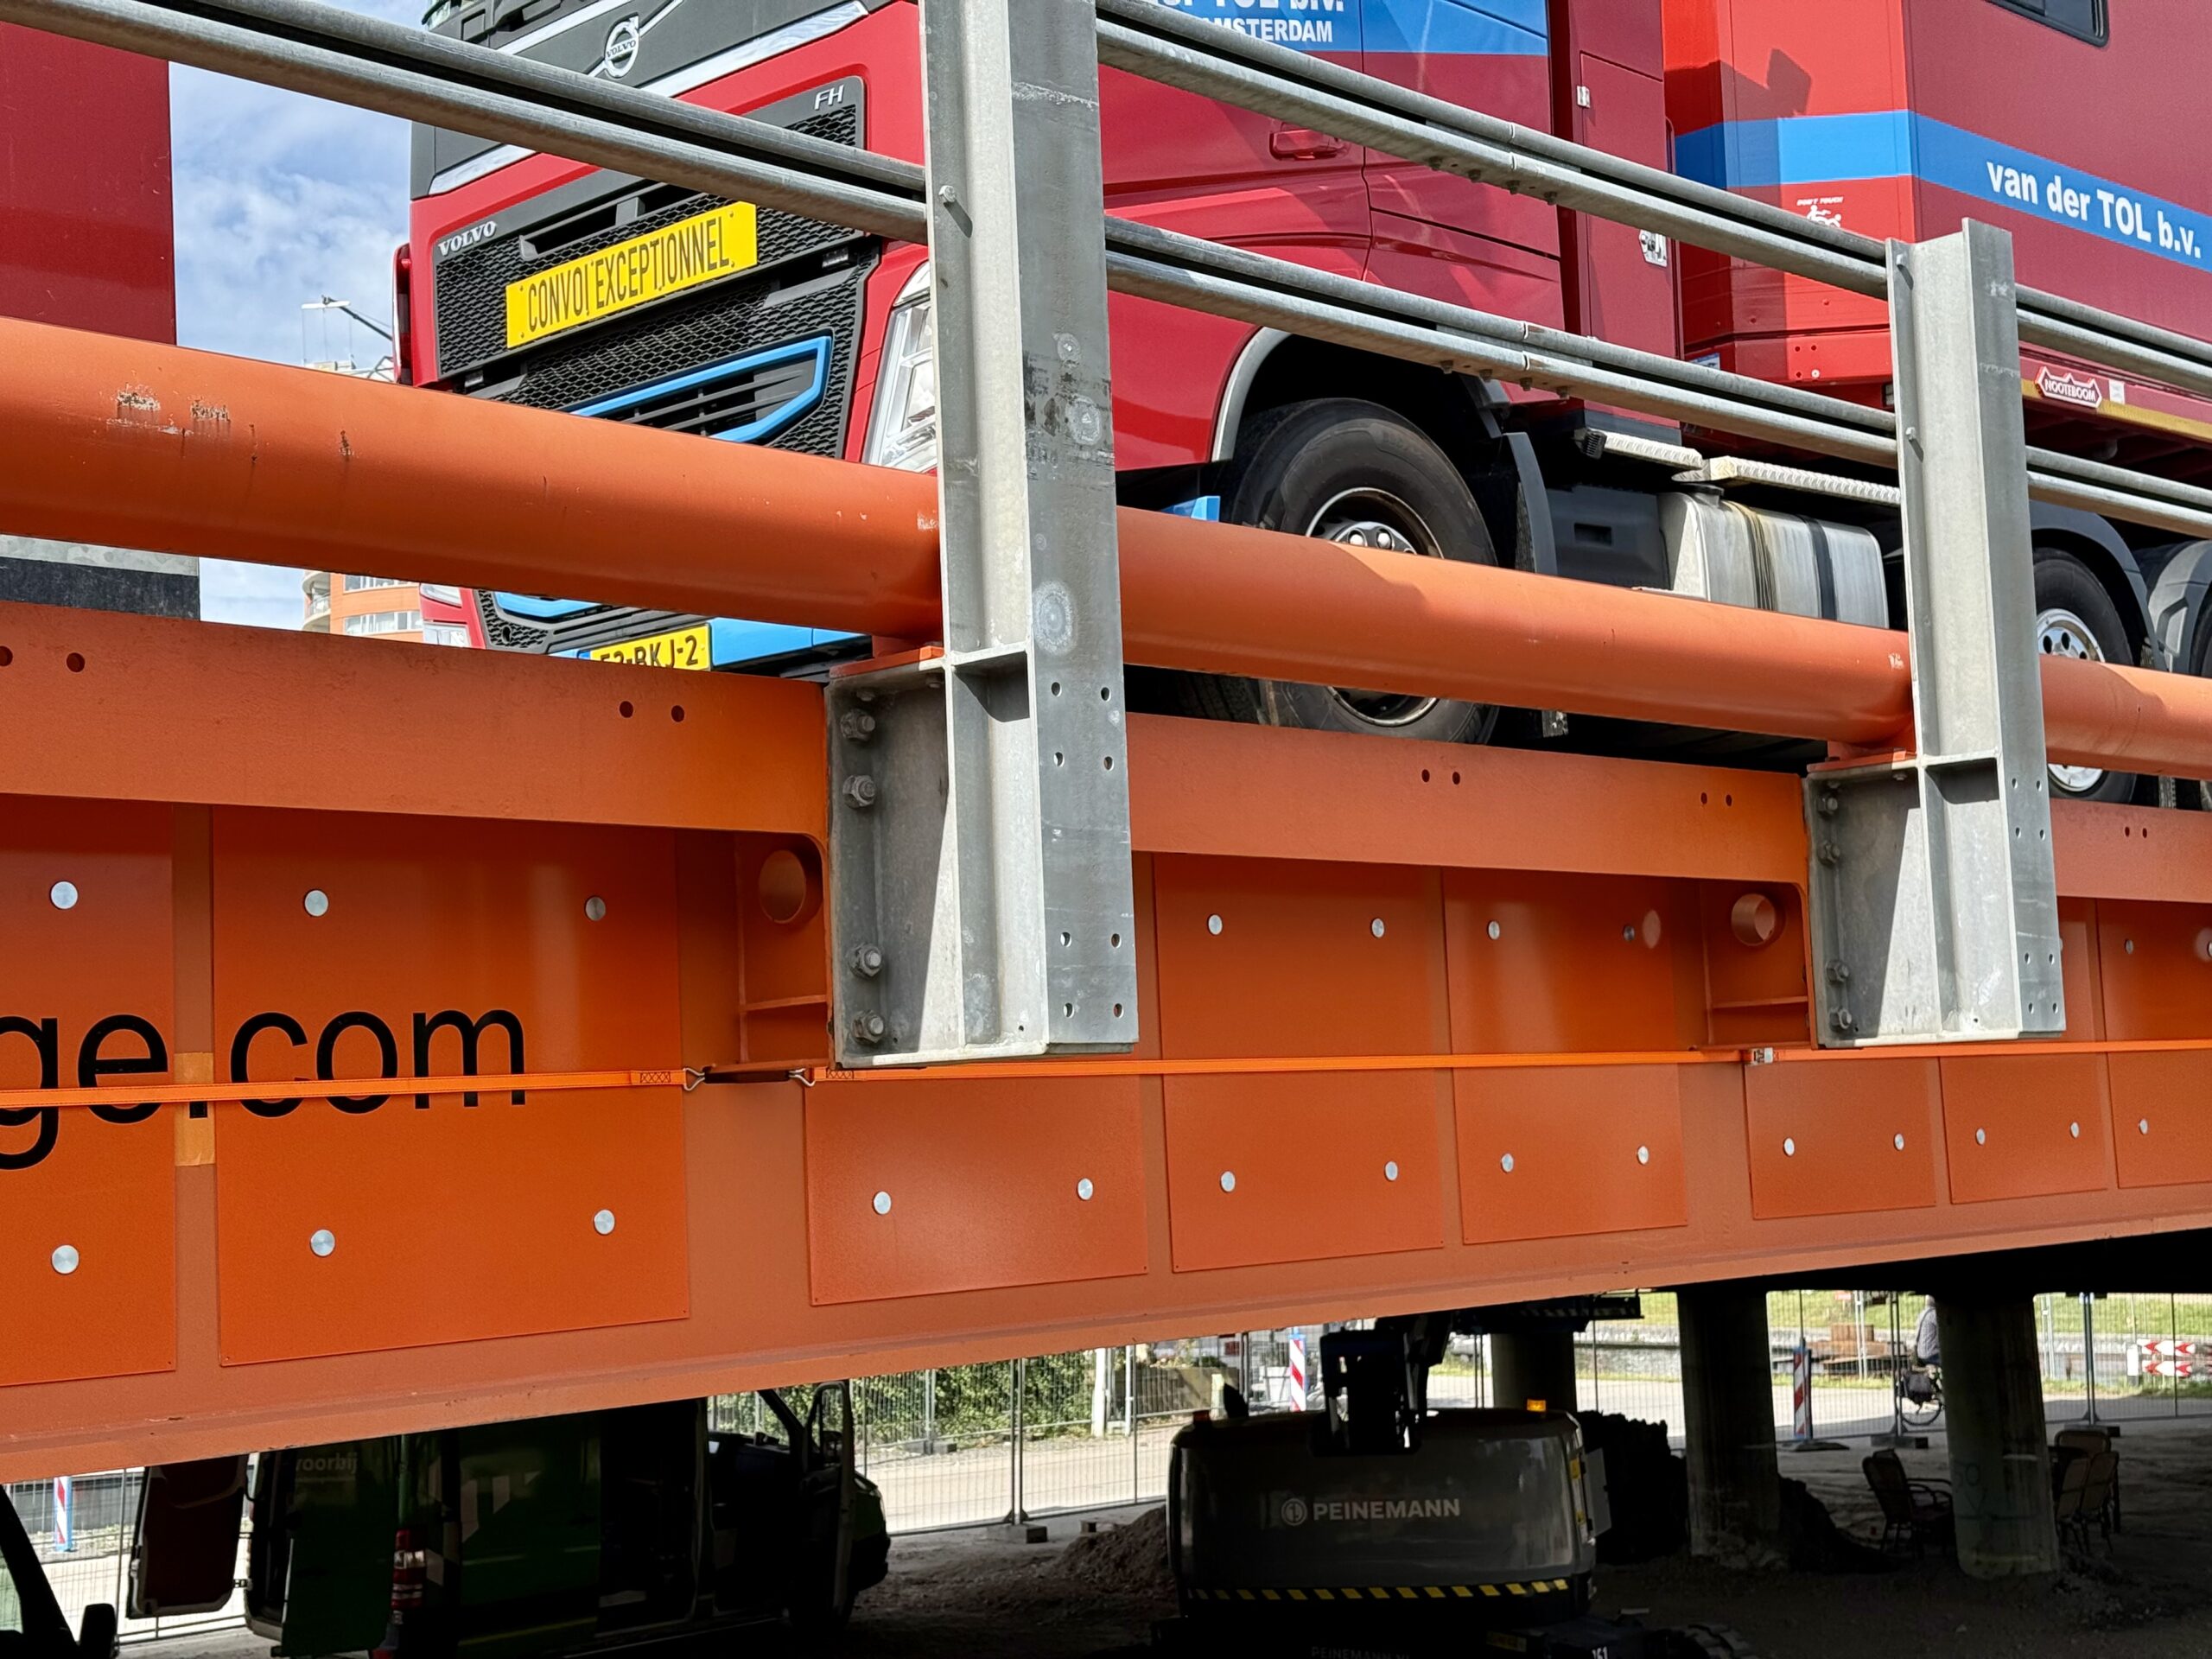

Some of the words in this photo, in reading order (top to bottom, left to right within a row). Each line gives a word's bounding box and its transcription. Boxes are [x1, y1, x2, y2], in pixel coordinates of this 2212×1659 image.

[1202, 17, 1333, 42] STERDAM
[607, 39, 637, 58] VOLVO
[814, 84, 844, 111] FH
[1986, 161, 2038, 205] van
[2046, 175, 2091, 222] der
[2096, 188, 2152, 243] TOL
[2157, 210, 2202, 259] b.v.
[438, 220, 497, 257] VOLVO
[527, 264, 589, 332] CONVOI
[596, 216, 730, 310] EXCEPTIONNEL
[2044, 378, 2096, 403] NOOTEBOOM
[600, 635, 698, 669] -BKJ-2
[0, 1009, 525, 1171] ge.com
[1313, 1498, 1460, 1521] PEINEMANN
